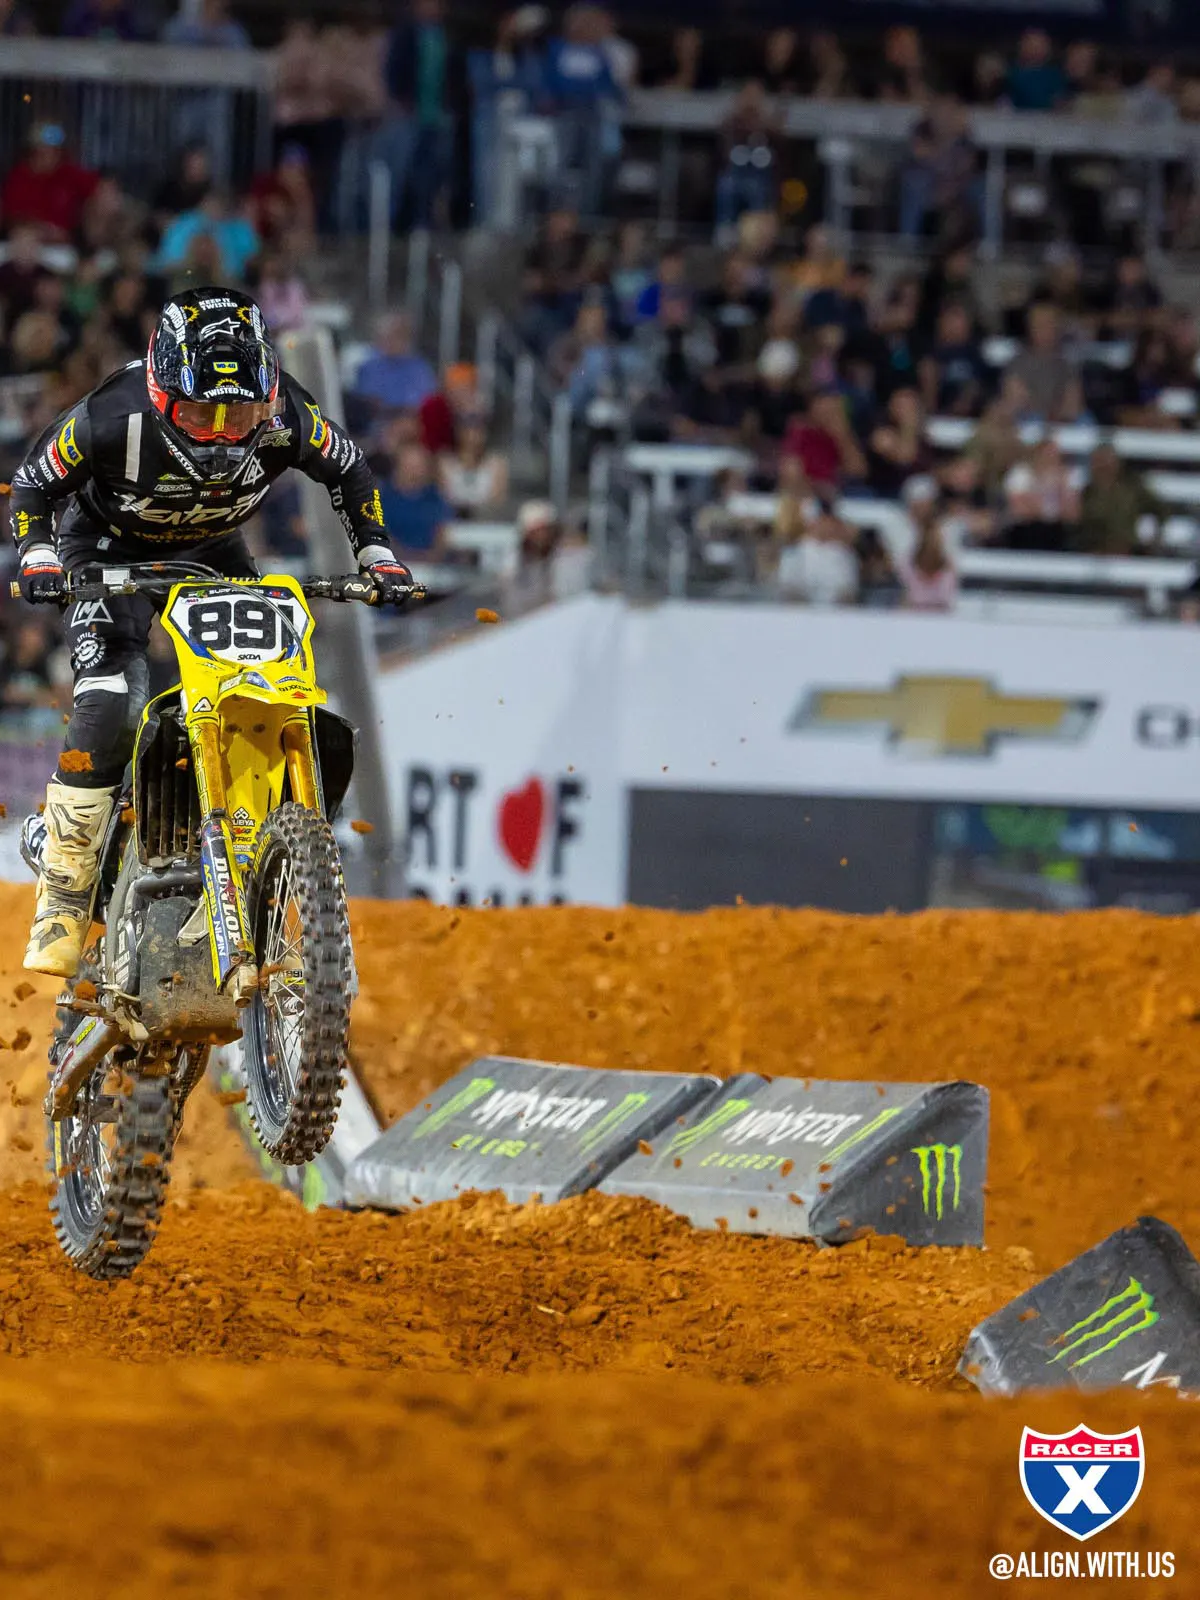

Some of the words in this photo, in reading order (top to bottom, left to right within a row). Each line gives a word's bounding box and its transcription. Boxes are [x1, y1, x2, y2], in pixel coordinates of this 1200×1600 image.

[201, 301, 238, 311] TWISTED
[203, 387, 239, 398] TWISTED
[239, 388, 255, 399] TEA
[343, 582, 371, 592] ASV
[188, 599, 295, 650] 891
[213, 856, 242, 945] DUNLOP
